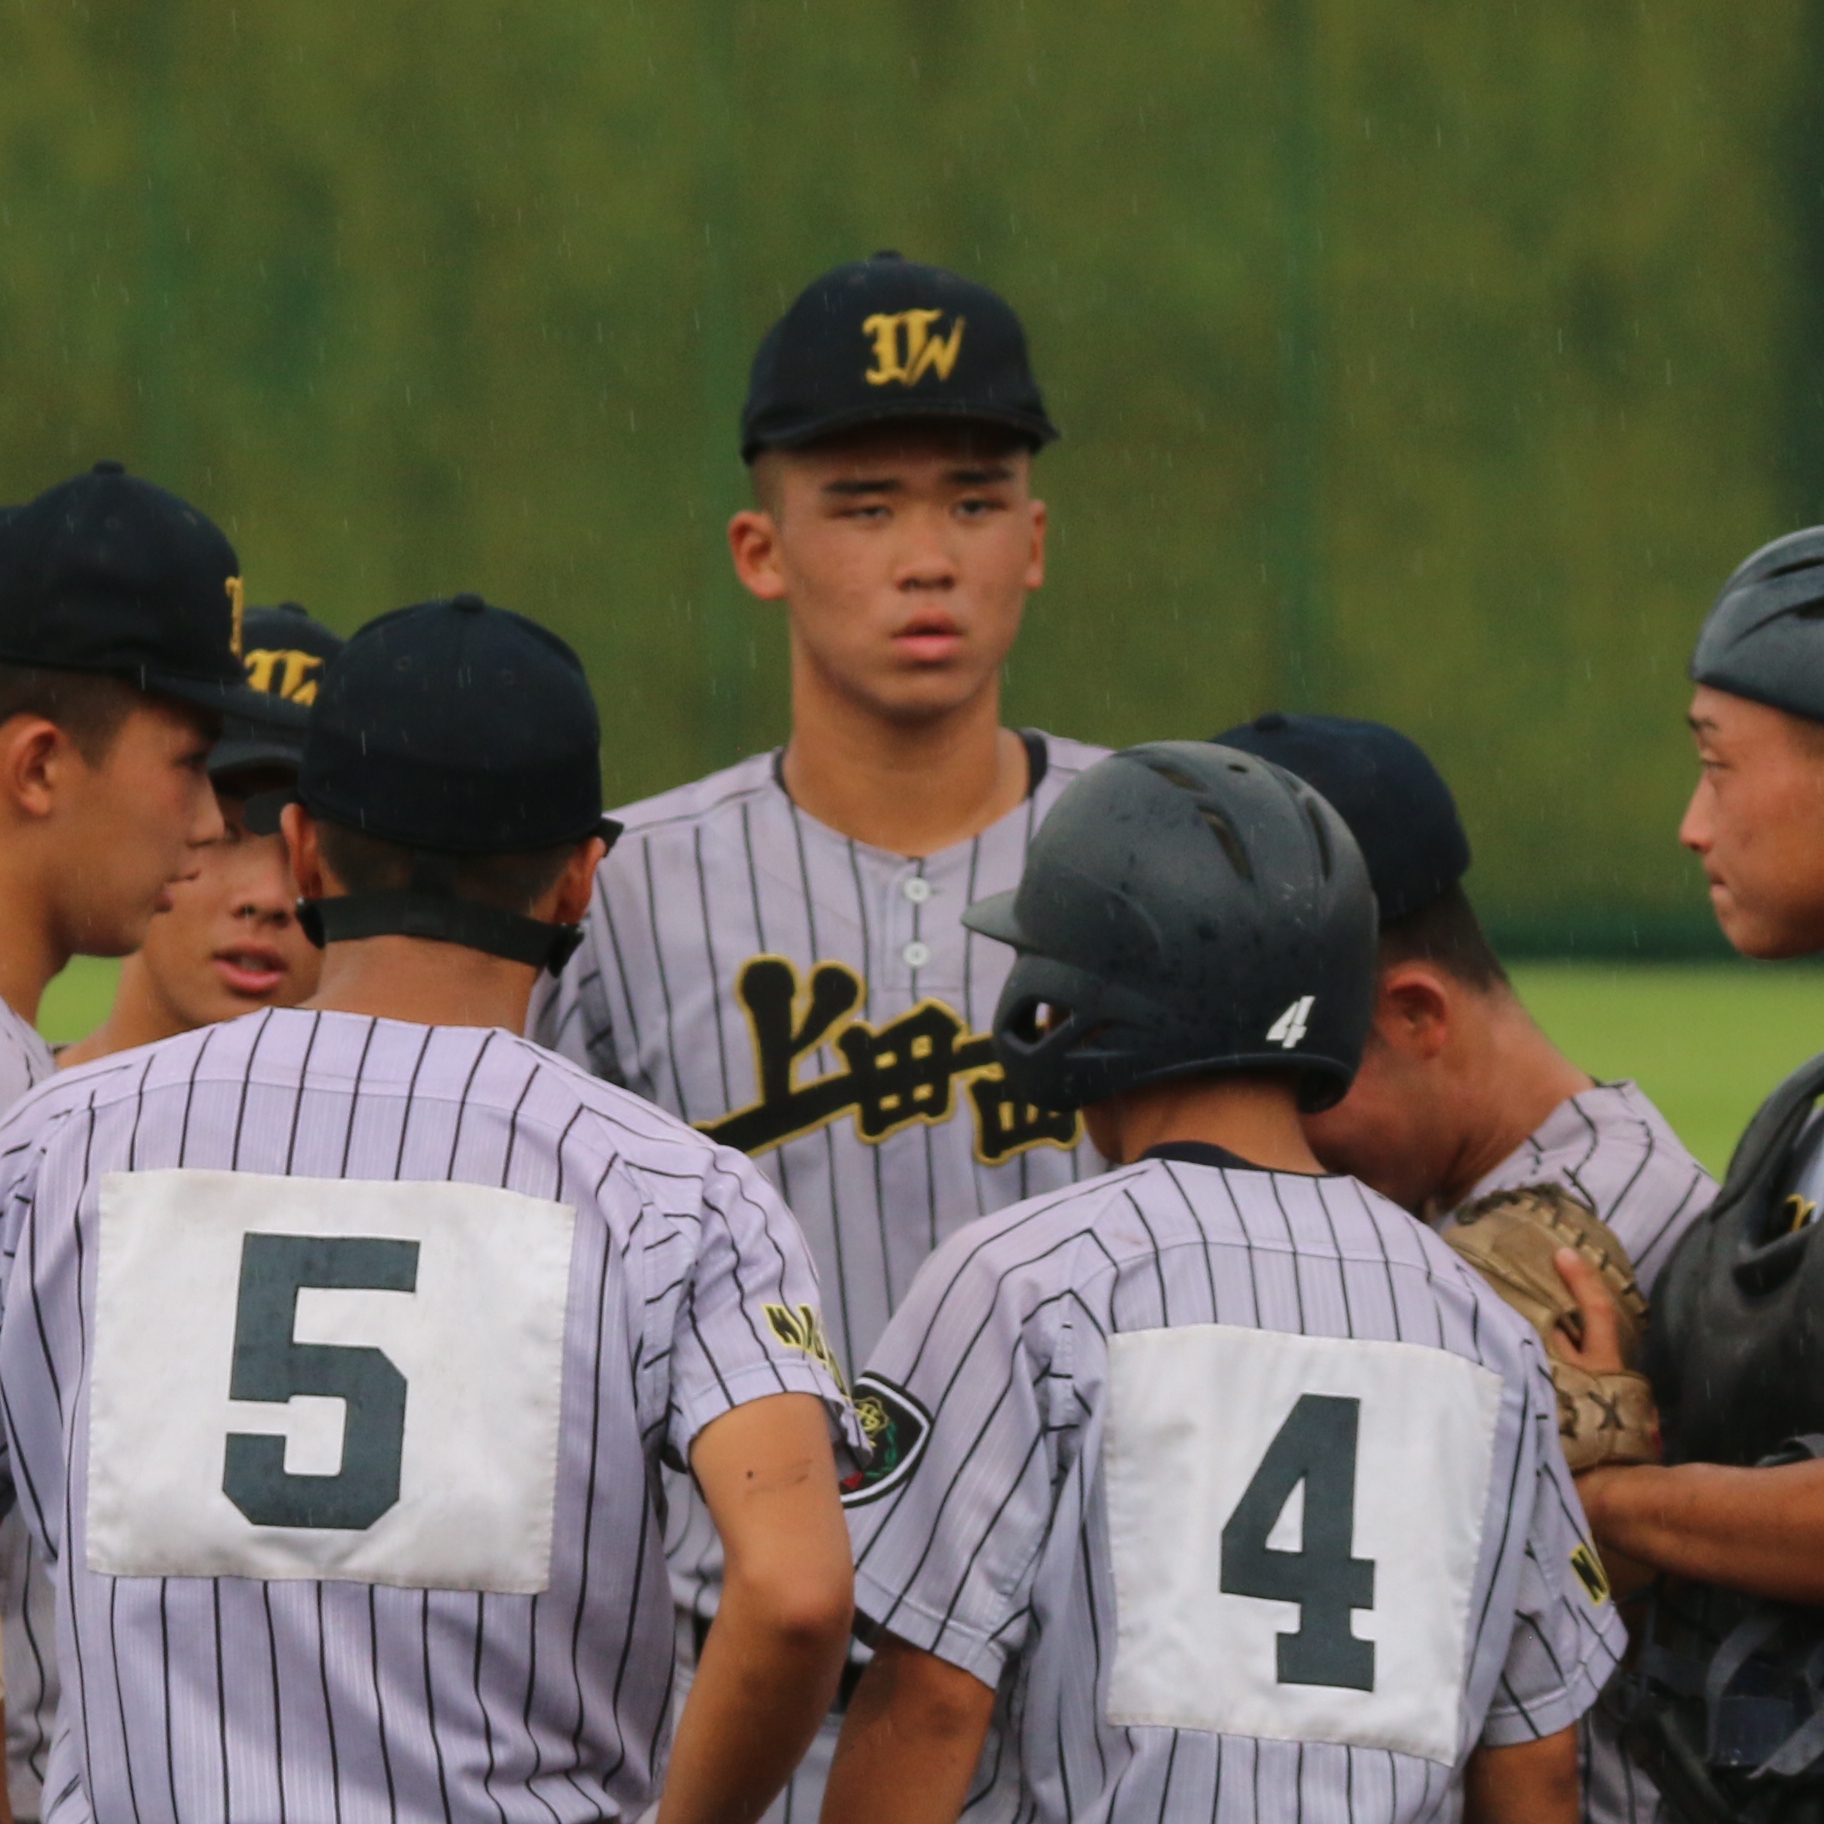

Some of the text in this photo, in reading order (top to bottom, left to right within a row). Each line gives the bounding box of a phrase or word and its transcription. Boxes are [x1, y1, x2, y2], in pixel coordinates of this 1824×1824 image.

[1265, 995, 1316, 1048] 4
[222, 1231, 421, 1531] 5
[1220, 1393, 1376, 1692] 4
